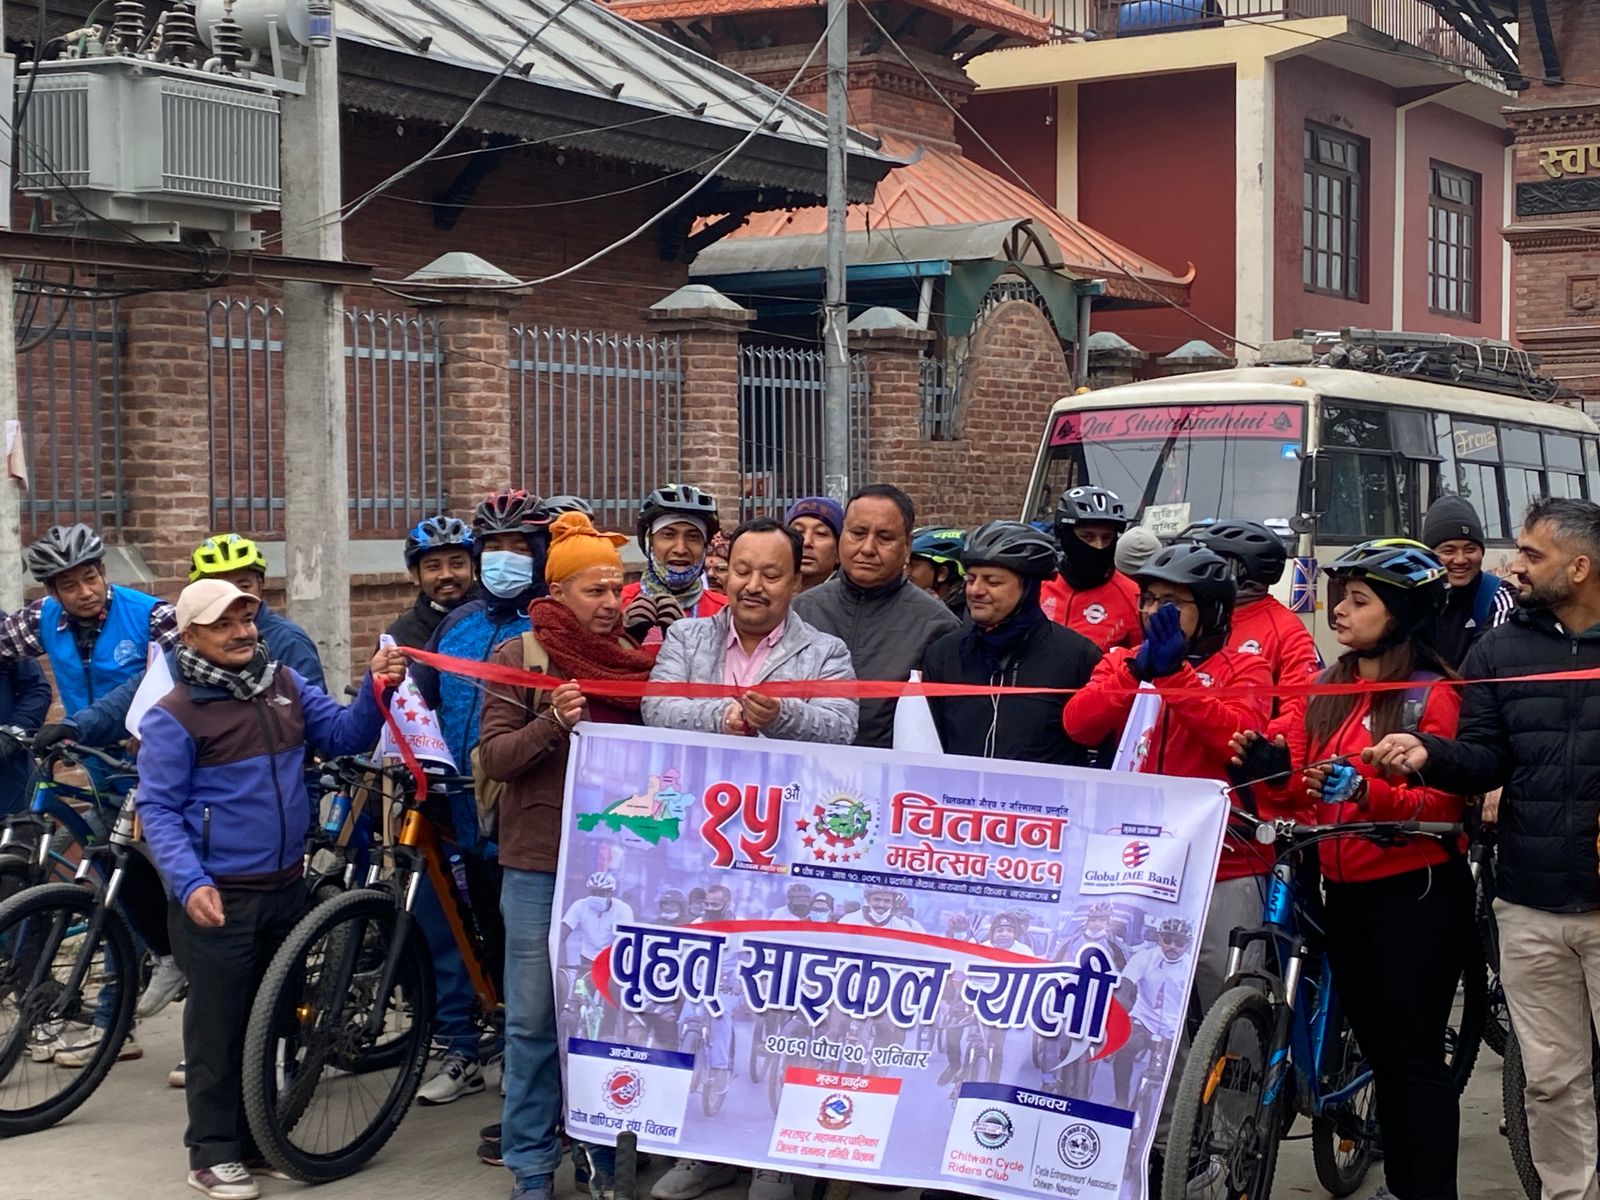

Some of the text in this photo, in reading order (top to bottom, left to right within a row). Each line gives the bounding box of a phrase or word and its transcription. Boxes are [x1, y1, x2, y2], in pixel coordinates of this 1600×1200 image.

[891, 792, 1068, 850] चितवन
[1085, 870, 1178, 887] Global IME Bank
[613, 925, 726, 1014] वृहत्
[740, 939, 950, 1026] साइकल
[766, 1036, 806, 1056] २०८१
[950, 1150, 1024, 1171] Chitwan Cycle
[948, 1161, 1009, 1182] Riders Club
[1035, 1164, 1049, 1177] Cycle
[1087, 1177, 1118, 1192] Association
